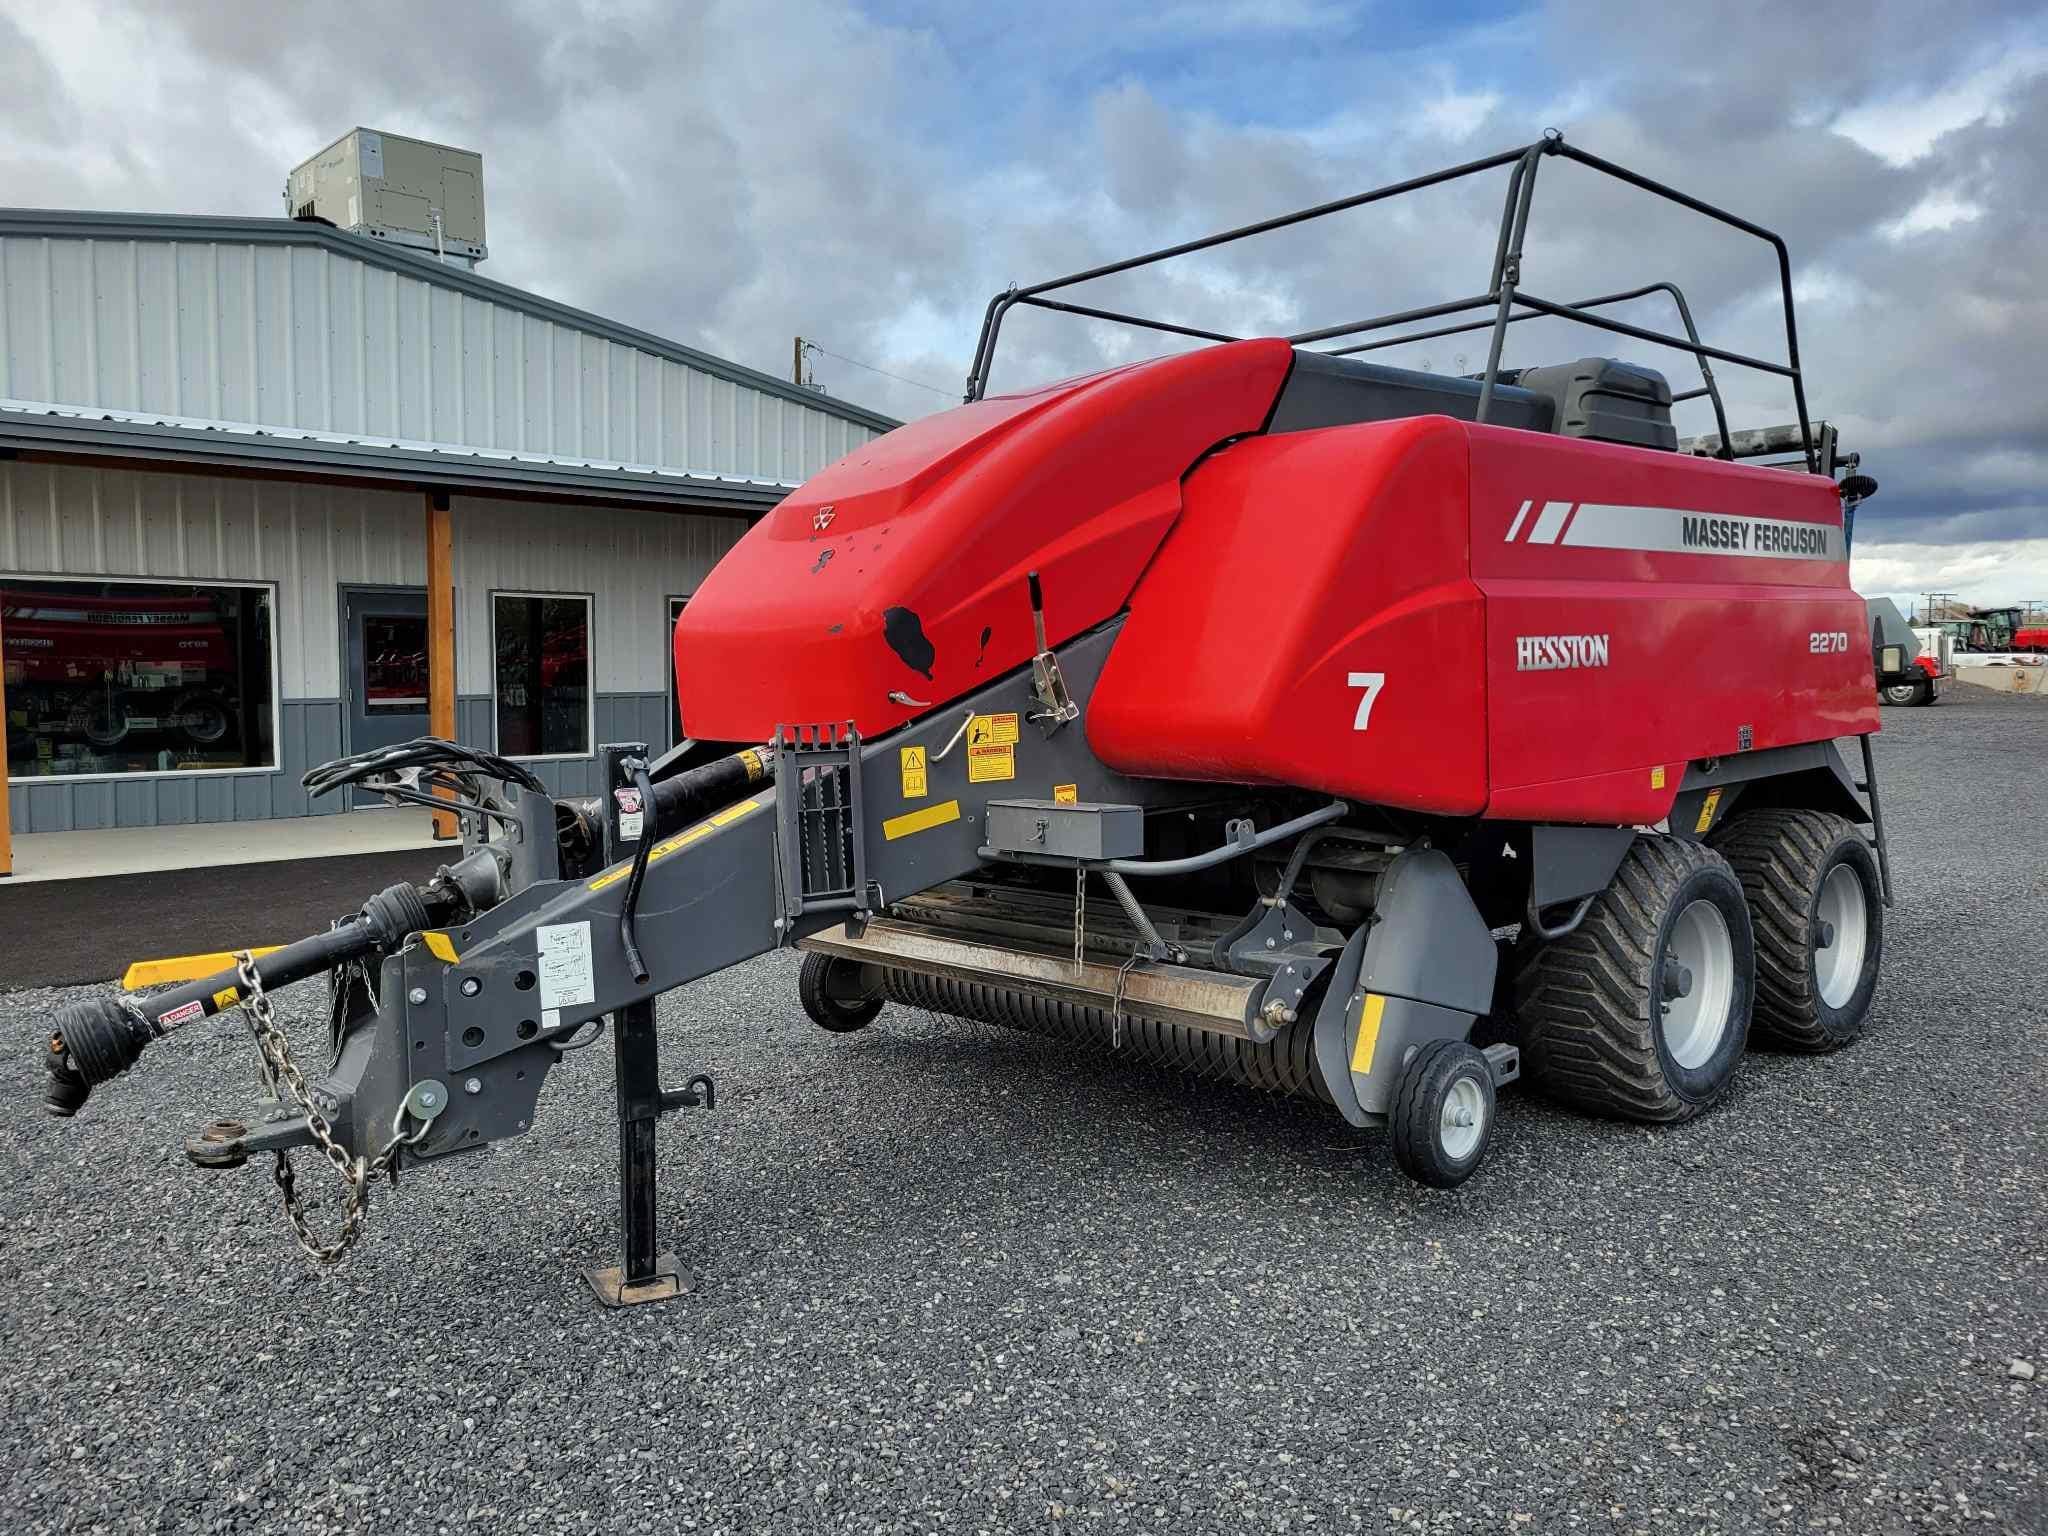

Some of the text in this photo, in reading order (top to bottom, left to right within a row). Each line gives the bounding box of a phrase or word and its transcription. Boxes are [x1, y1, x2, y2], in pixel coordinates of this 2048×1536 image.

[1682, 516, 1827, 554] MASSEY FERGUSON
[1516, 634, 1609, 671] HESSTON
[1809, 631, 1848, 653] 2270
[1347, 672, 1385, 731] 7
[170, 1004, 200, 1021] DANGER
